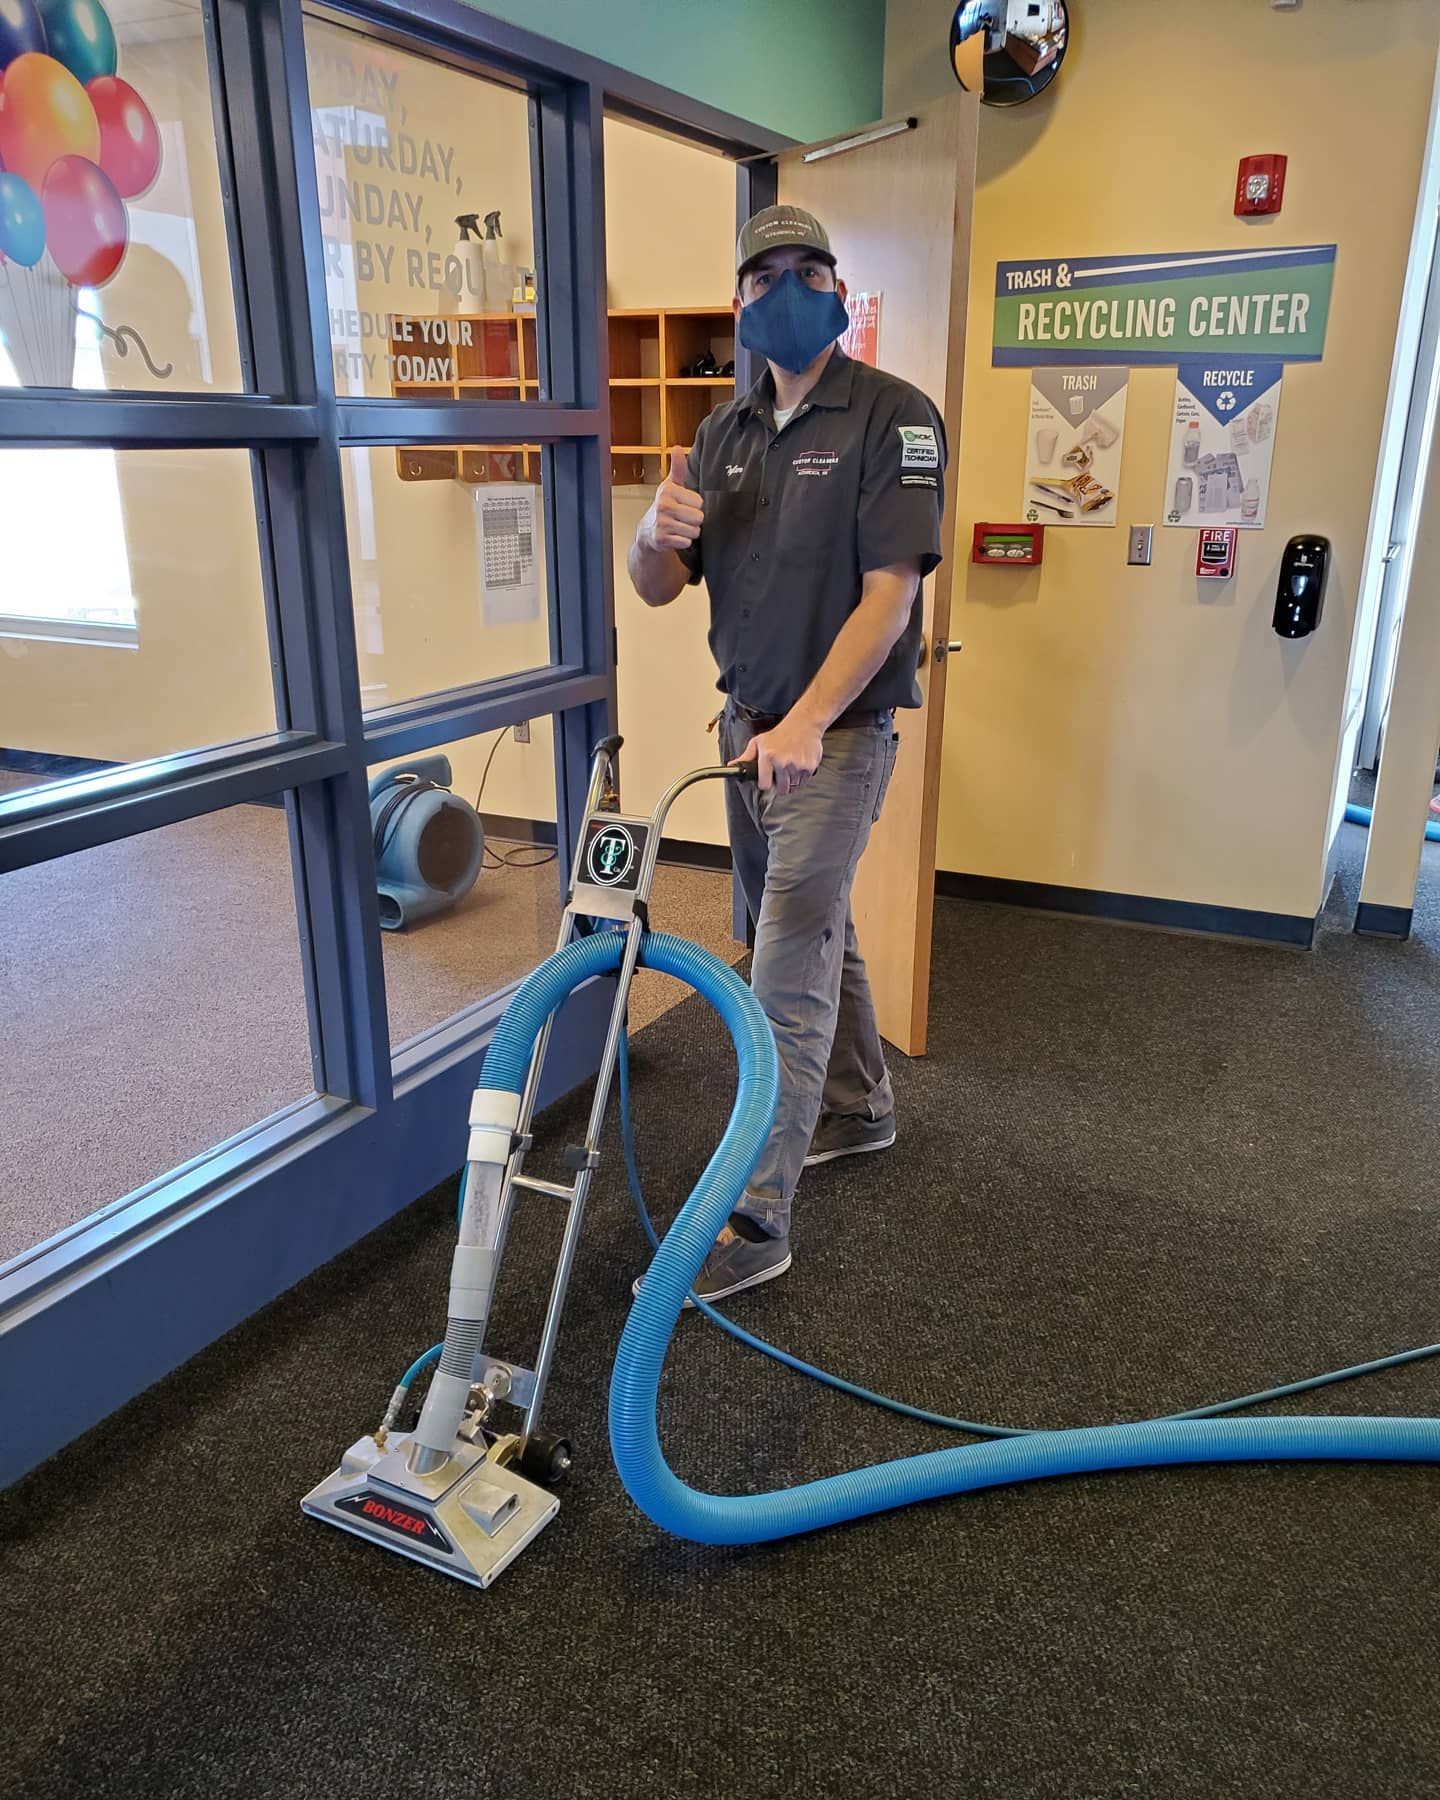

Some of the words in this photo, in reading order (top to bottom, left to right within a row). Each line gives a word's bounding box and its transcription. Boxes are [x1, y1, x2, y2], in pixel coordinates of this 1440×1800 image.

[312, 110, 462, 196] ATURDAY,
[320, 176, 432, 244] UNDAY,
[357, 240, 395, 284] BY
[1006, 269, 1051, 290] TRASH
[1055, 263, 1072, 288] &
[330, 309, 413, 342] HEDULE
[419, 318, 473, 347] YOUR
[1017, 298, 1176, 341] RECYCLING
[1188, 293, 1311, 336] CENTER
[334, 352, 376, 380] RTY
[1203, 370, 1255, 387] RECYCLE
[1062, 375, 1098, 391] TRASH
[906, 447, 935, 455] CERTIFIED
[1203, 530, 1231, 542] FIRE
[362, 1499, 427, 1536] BONZER
